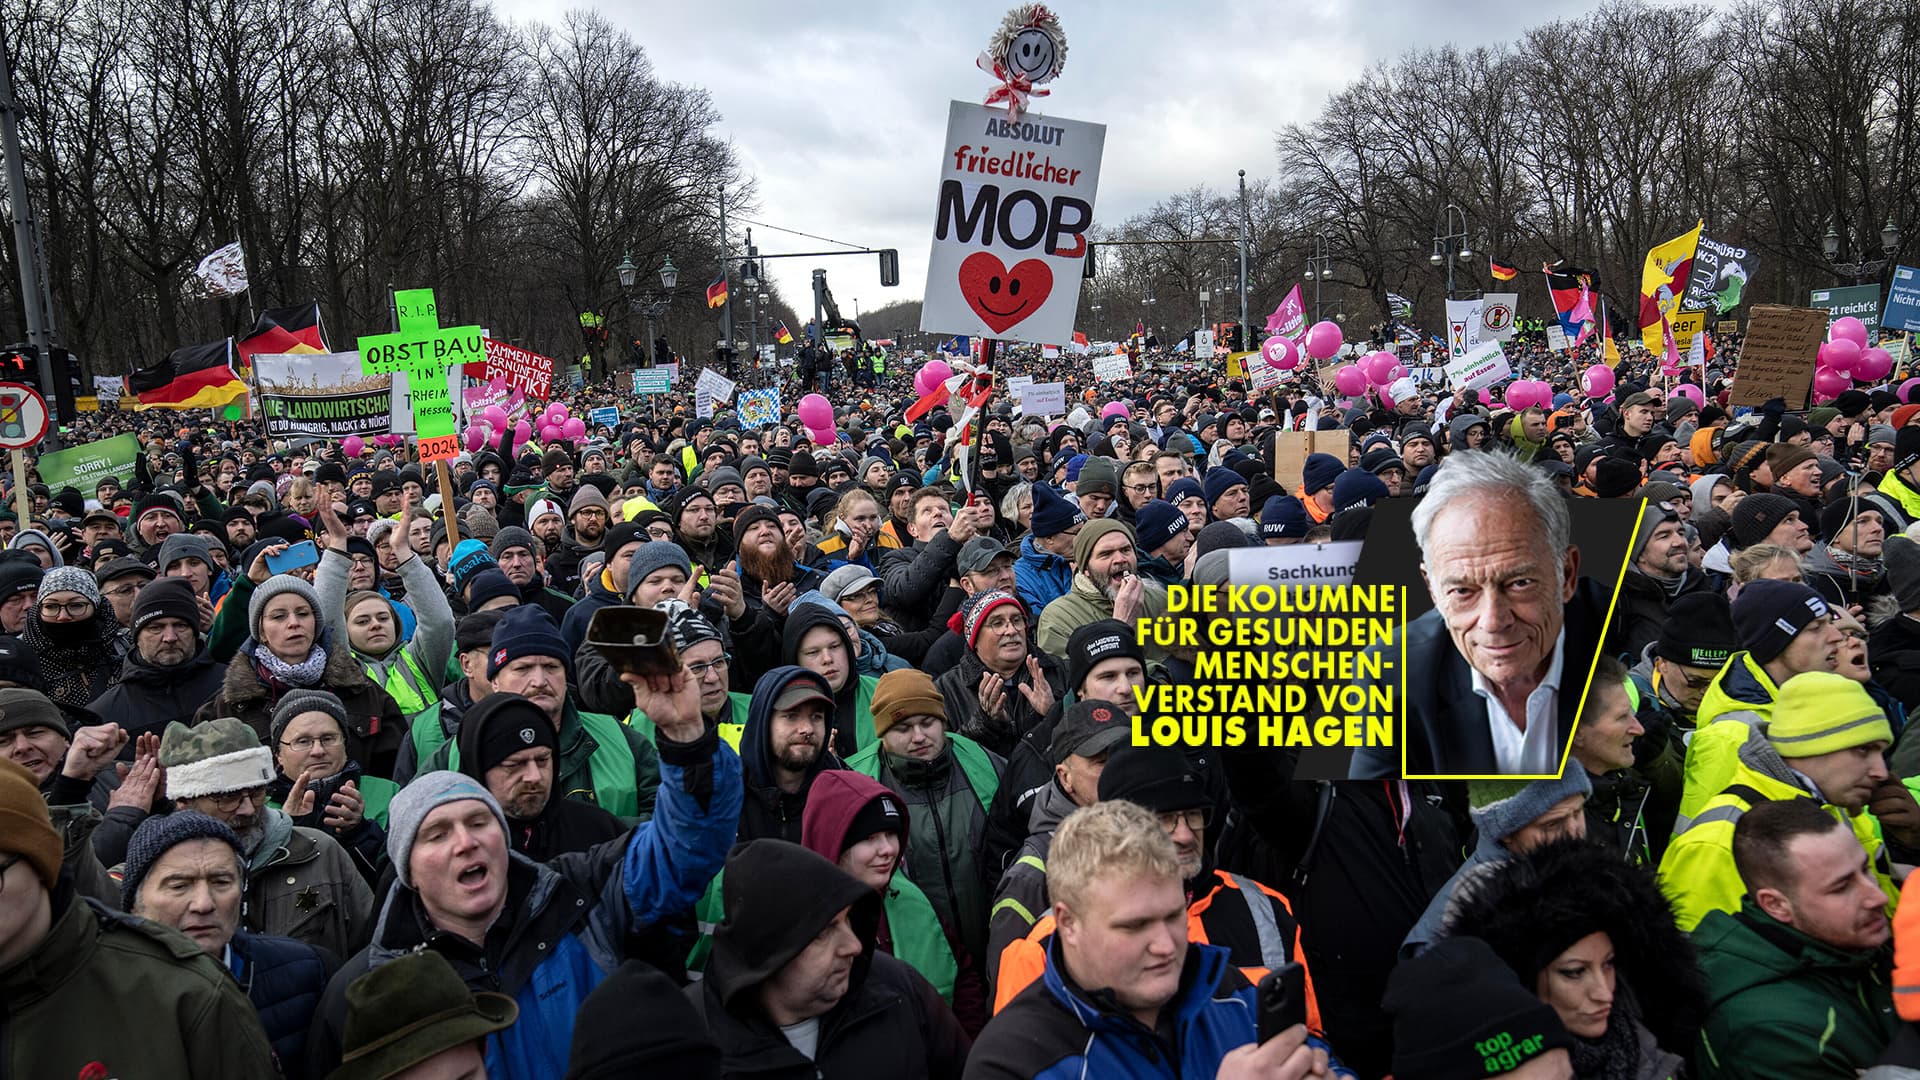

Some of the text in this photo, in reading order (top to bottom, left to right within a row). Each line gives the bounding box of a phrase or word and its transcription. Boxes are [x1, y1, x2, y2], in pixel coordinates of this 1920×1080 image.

[985, 117, 1065, 147] ABSOLUT
[954, 144, 1082, 186] friedlicher
[936, 179, 1093, 259] MOB
[1893, 293, 1914, 306] Nicht
[1671, 320, 1696, 332] eer
[367, 336, 481, 364] OBSTBAU
[485, 341, 531, 365] SAMMEN
[418, 367, 434, 380] IN
[1463, 363, 1497, 382] auf Essen
[287, 394, 390, 419] LANDWIRTSCHA
[278, 419, 288, 430] DU
[290, 421, 331, 434] HUNGRIG,
[331, 419, 358, 432] NACKT
[360, 418, 368, 430] &
[369, 415, 390, 428] NÜCHT
[421, 439, 457, 458] 2024
[108, 461, 137, 474] LANGSAM
[1167, 514, 1187, 534] RUW
[1263, 523, 1285, 533] RUW
[1268, 562, 1358, 580] Sachkund
[1475, 1032, 1512, 1057] top
[1484, 1034, 1544, 1072] agrar
